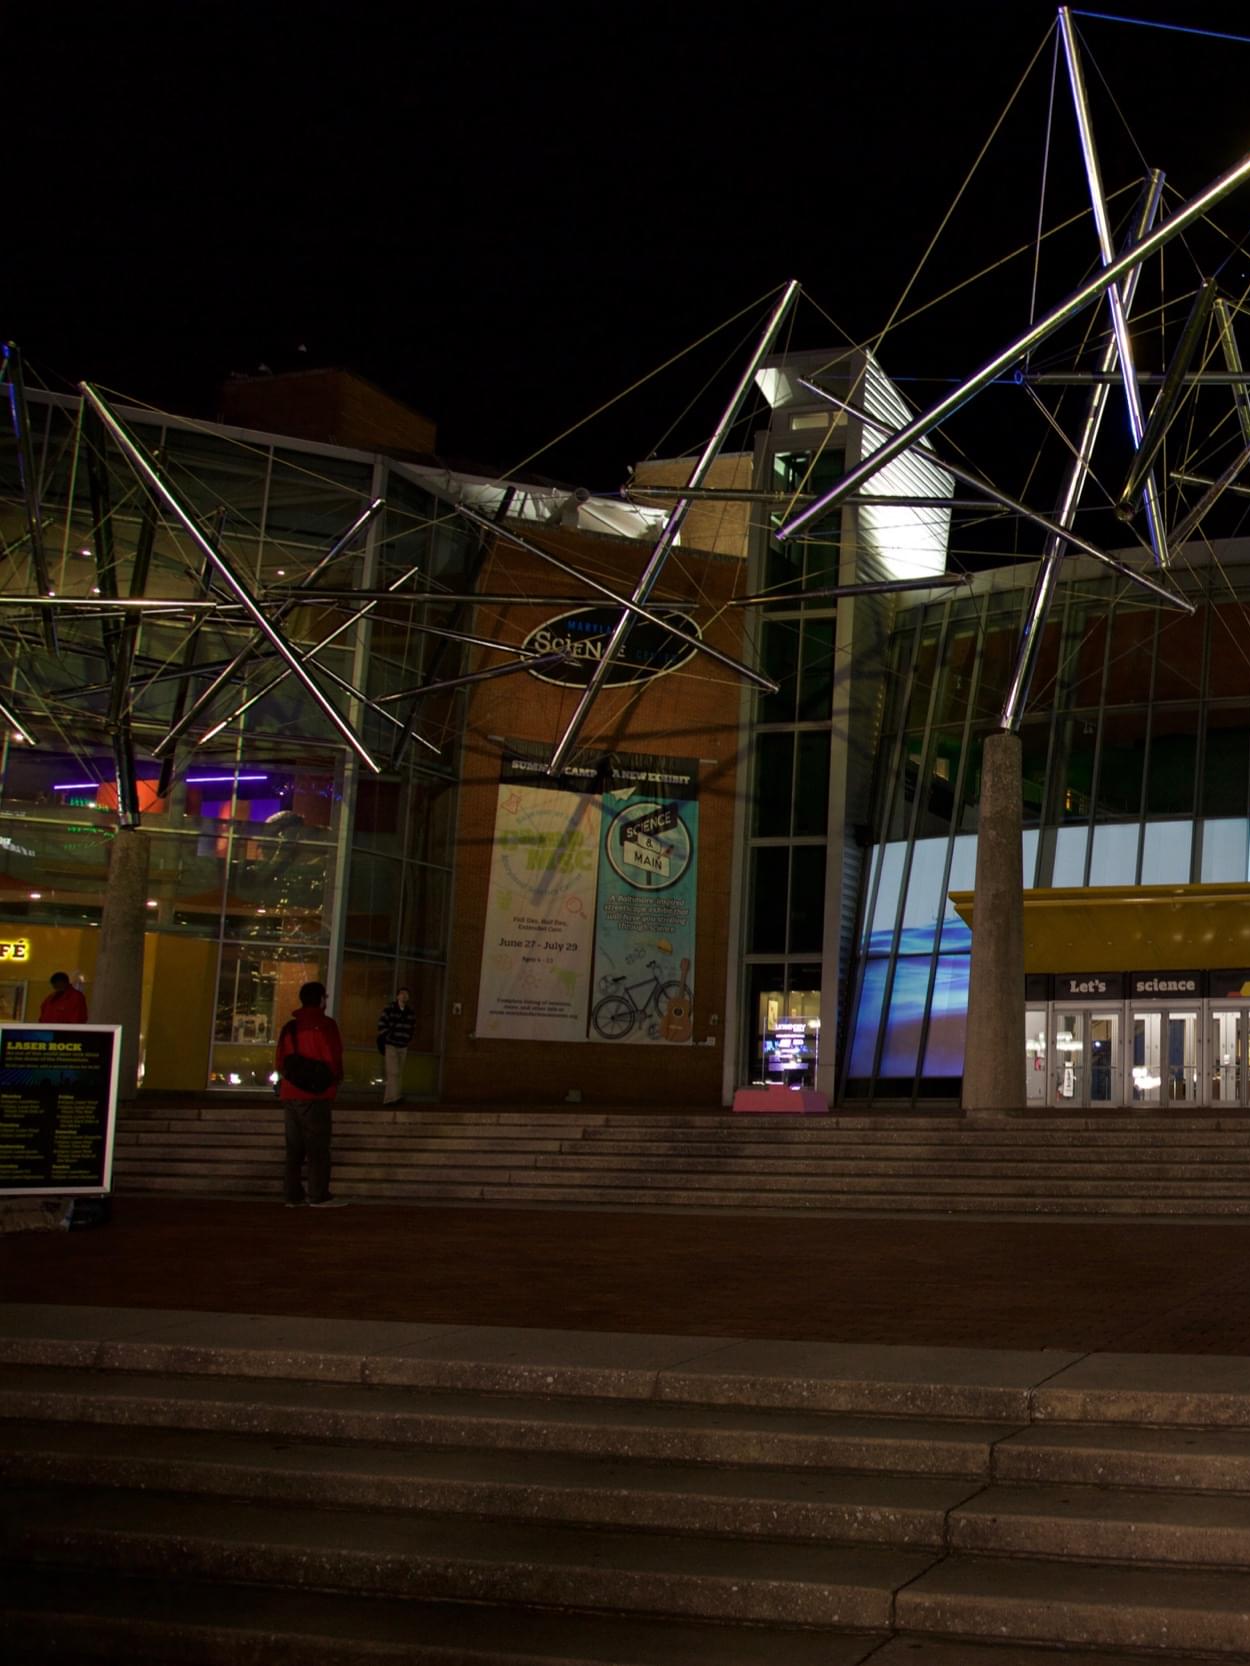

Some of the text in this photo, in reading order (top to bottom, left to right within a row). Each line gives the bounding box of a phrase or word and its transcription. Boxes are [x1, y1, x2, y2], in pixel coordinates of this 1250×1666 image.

[566, 618, 613, 634] MARYLA
[535, 630, 627, 659] SciENE
[512, 760, 598, 778] SUMM CAMP
[612, 768, 691, 784] A NEW EXHIBIT
[626, 811, 672, 839] SCIENCE
[646, 839, 654, 848] &
[634, 851, 662, 870] MAIN
[499, 937, 523, 948] June
[525, 940, 536, 948] 27
[543, 942, 563, 952] July
[566, 943, 578, 951] 29
[1070, 978, 1196, 993] Let's science
[7, 1041, 82, 1052] LASER ROCK
